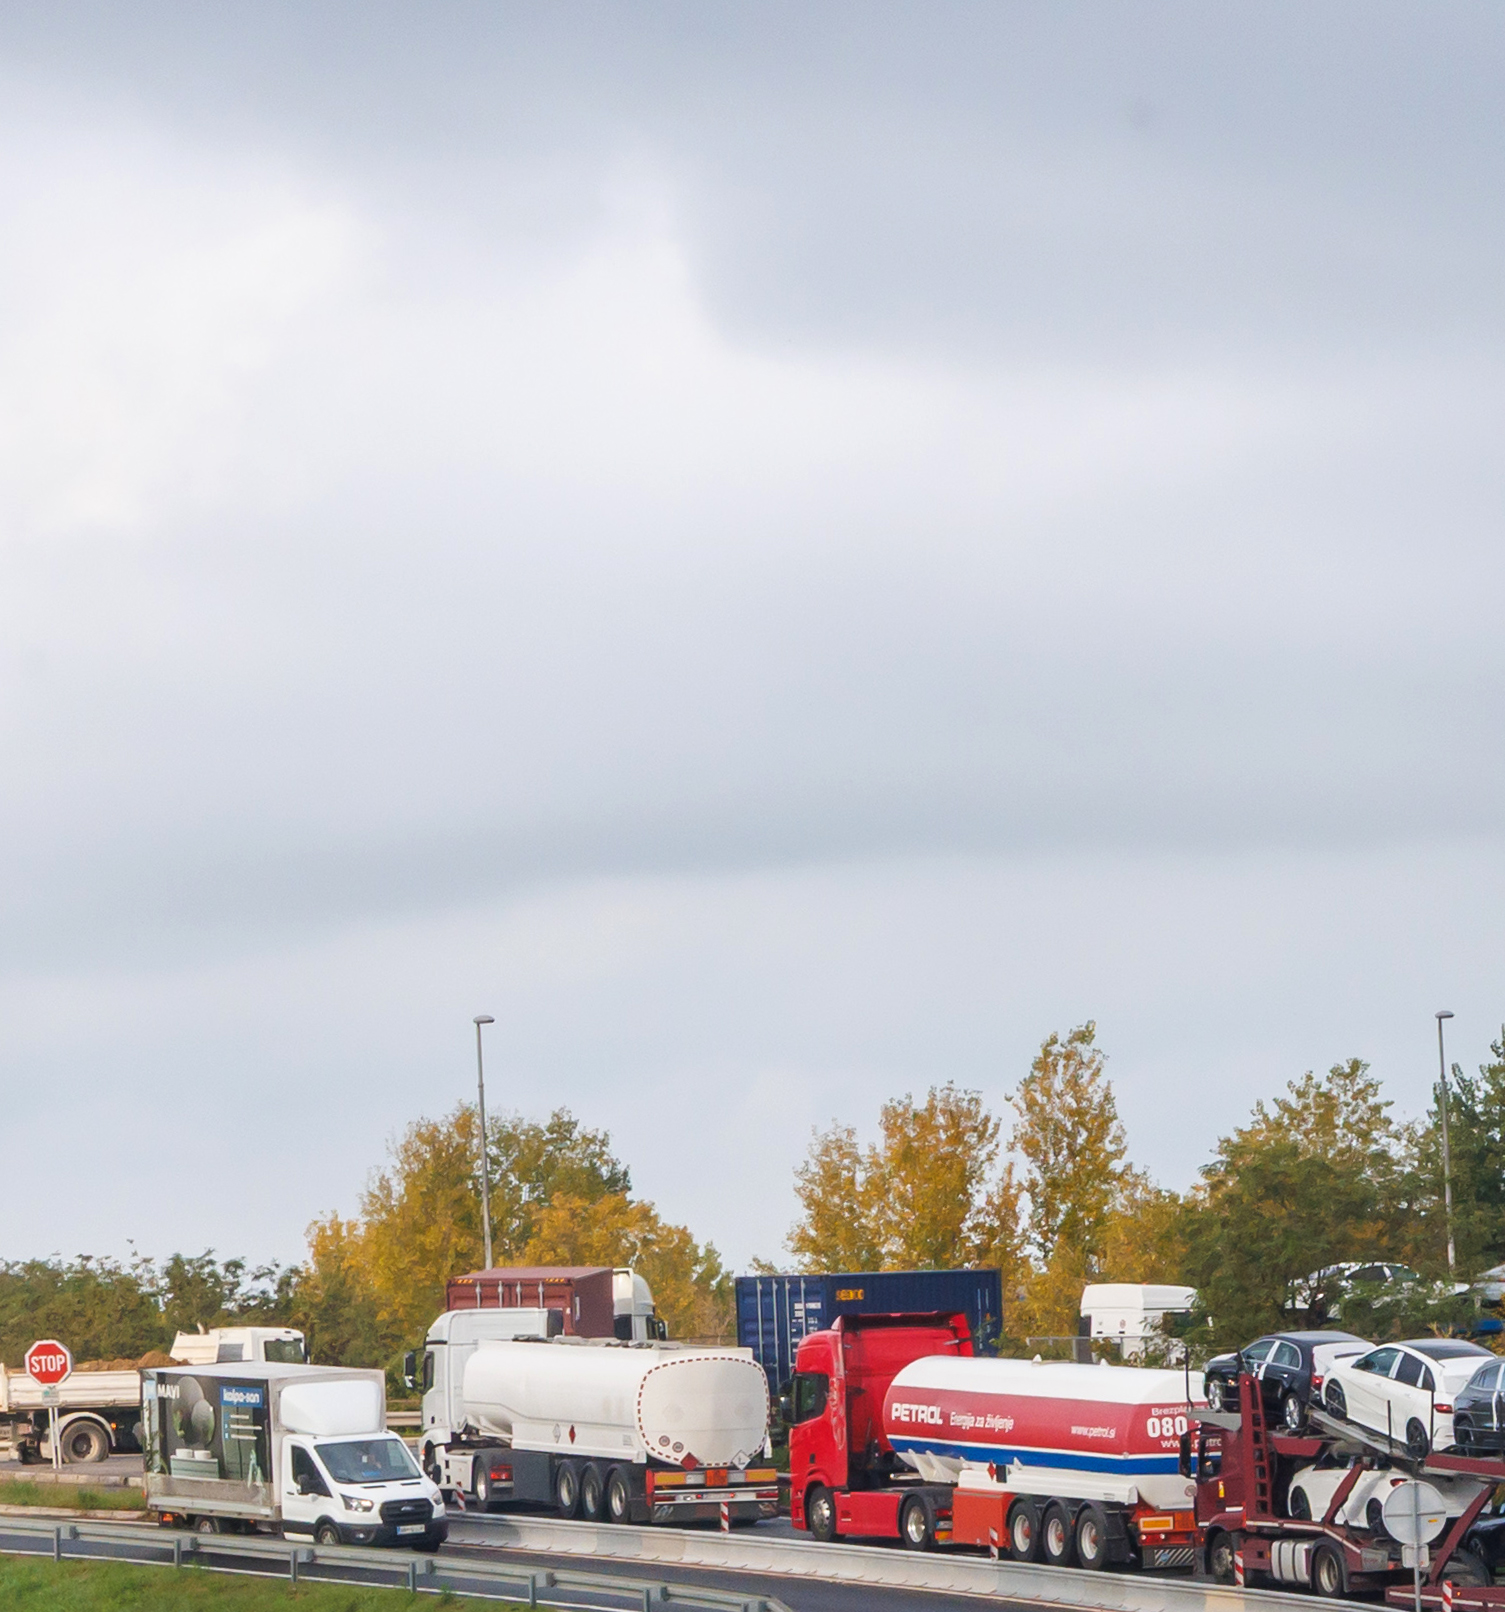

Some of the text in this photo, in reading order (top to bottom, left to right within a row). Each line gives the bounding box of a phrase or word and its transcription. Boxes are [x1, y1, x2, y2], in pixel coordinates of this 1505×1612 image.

[31, 1354, 65, 1373] STOP
[892, 1402, 944, 1425] PETROL
[1146, 1416, 1188, 1438] 080
